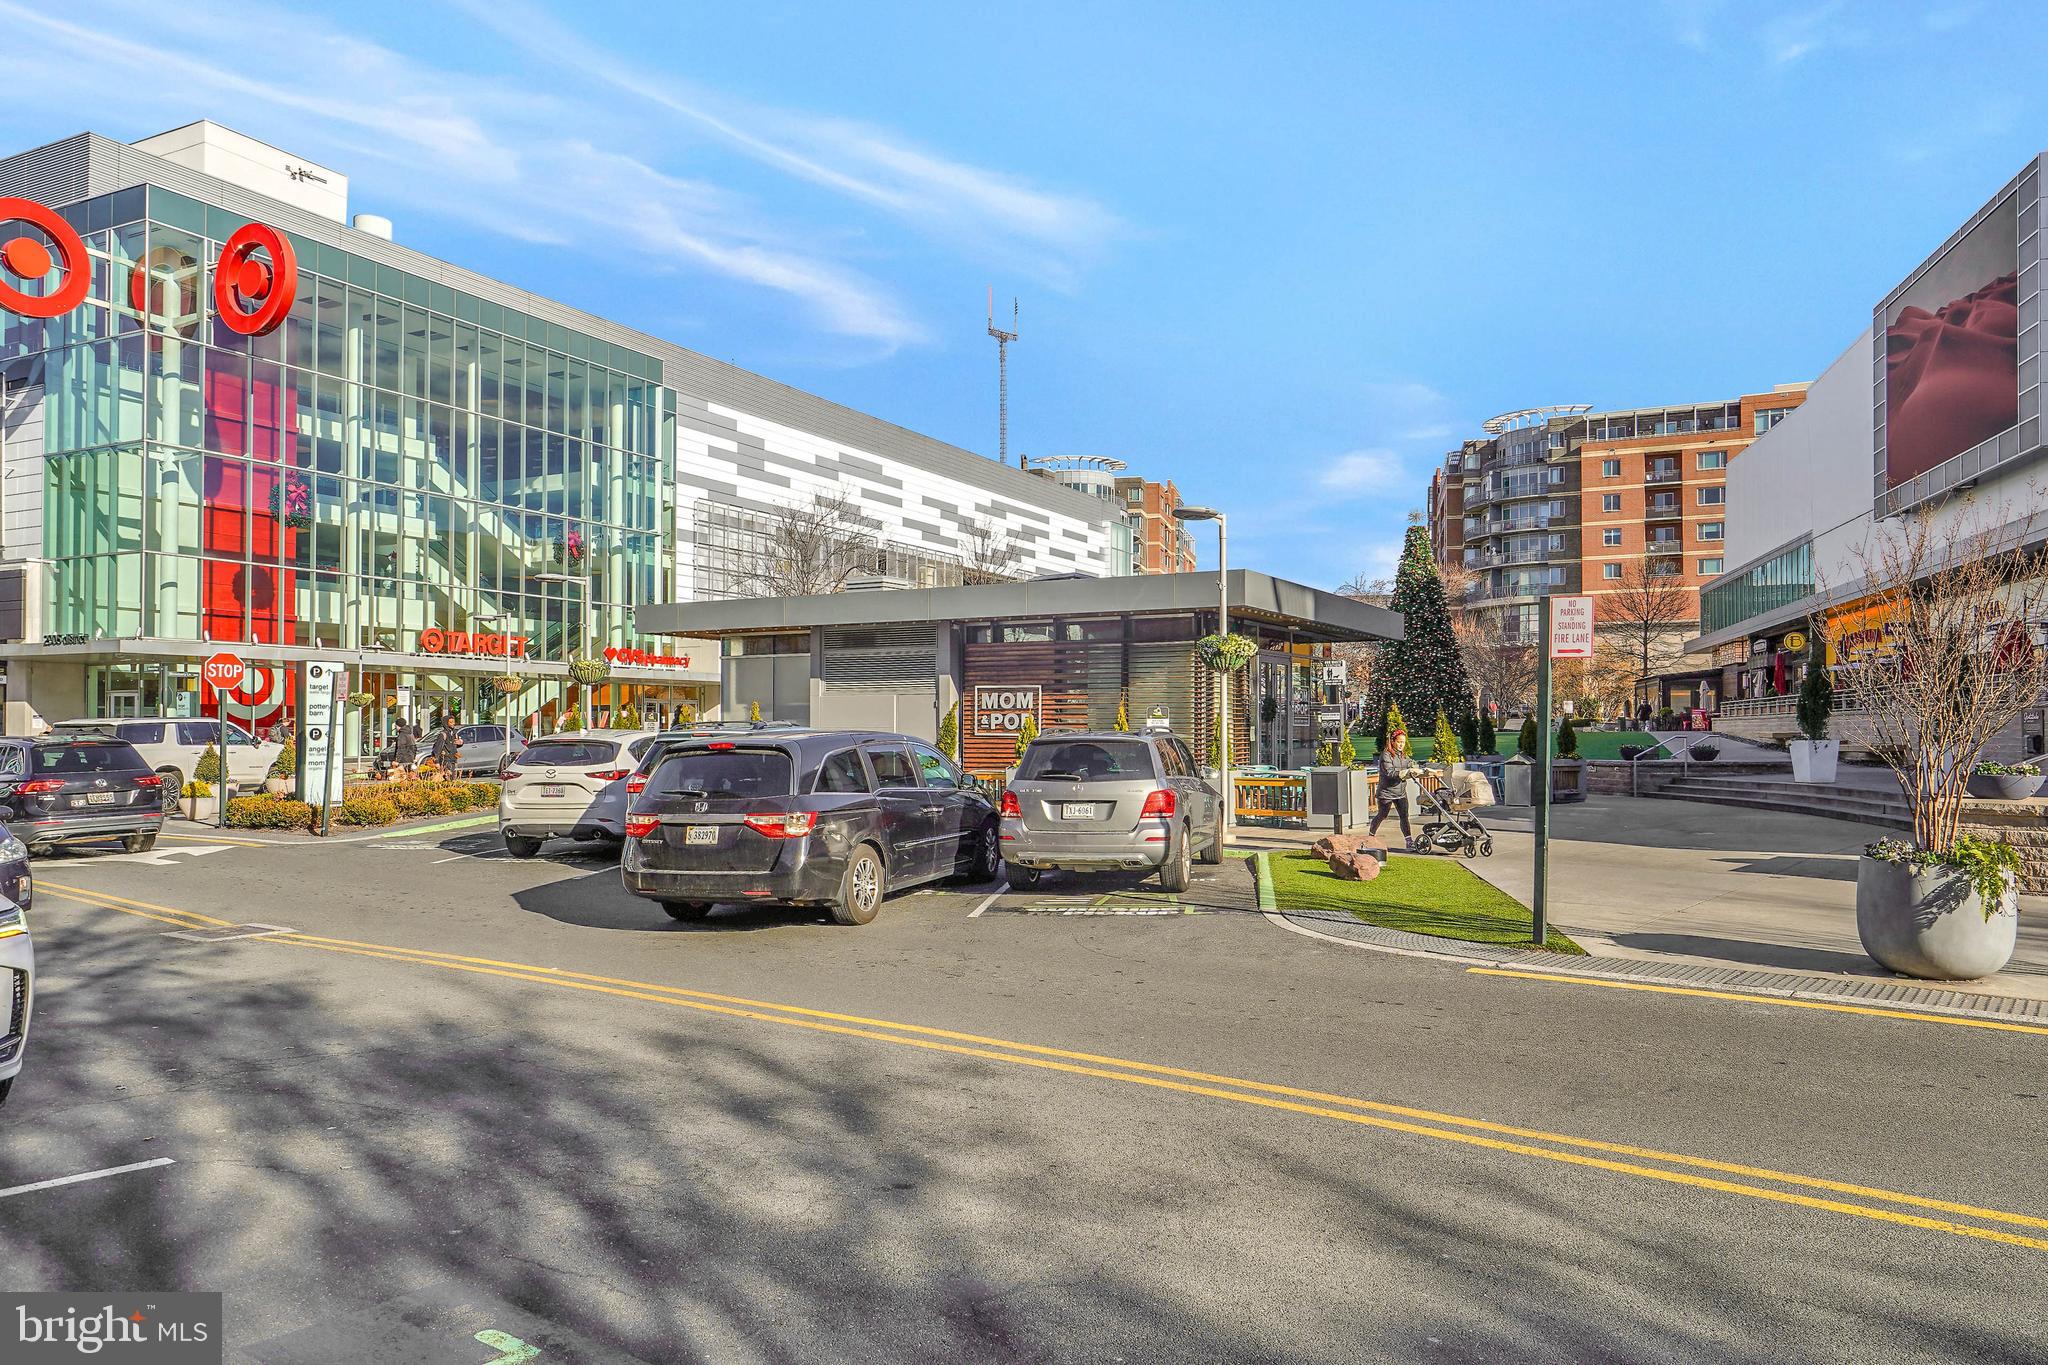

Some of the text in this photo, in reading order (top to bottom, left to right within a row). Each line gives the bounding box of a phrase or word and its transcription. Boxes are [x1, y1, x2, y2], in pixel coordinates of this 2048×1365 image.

[1560, 608, 1585, 616] PARKING
[1558, 621, 1586, 630] STANDING
[444, 630, 528, 657] TARGET
[1554, 633, 1590, 643] FIRE LANE
[207, 663, 243, 678] STOP
[981, 692, 1034, 709] MOM
